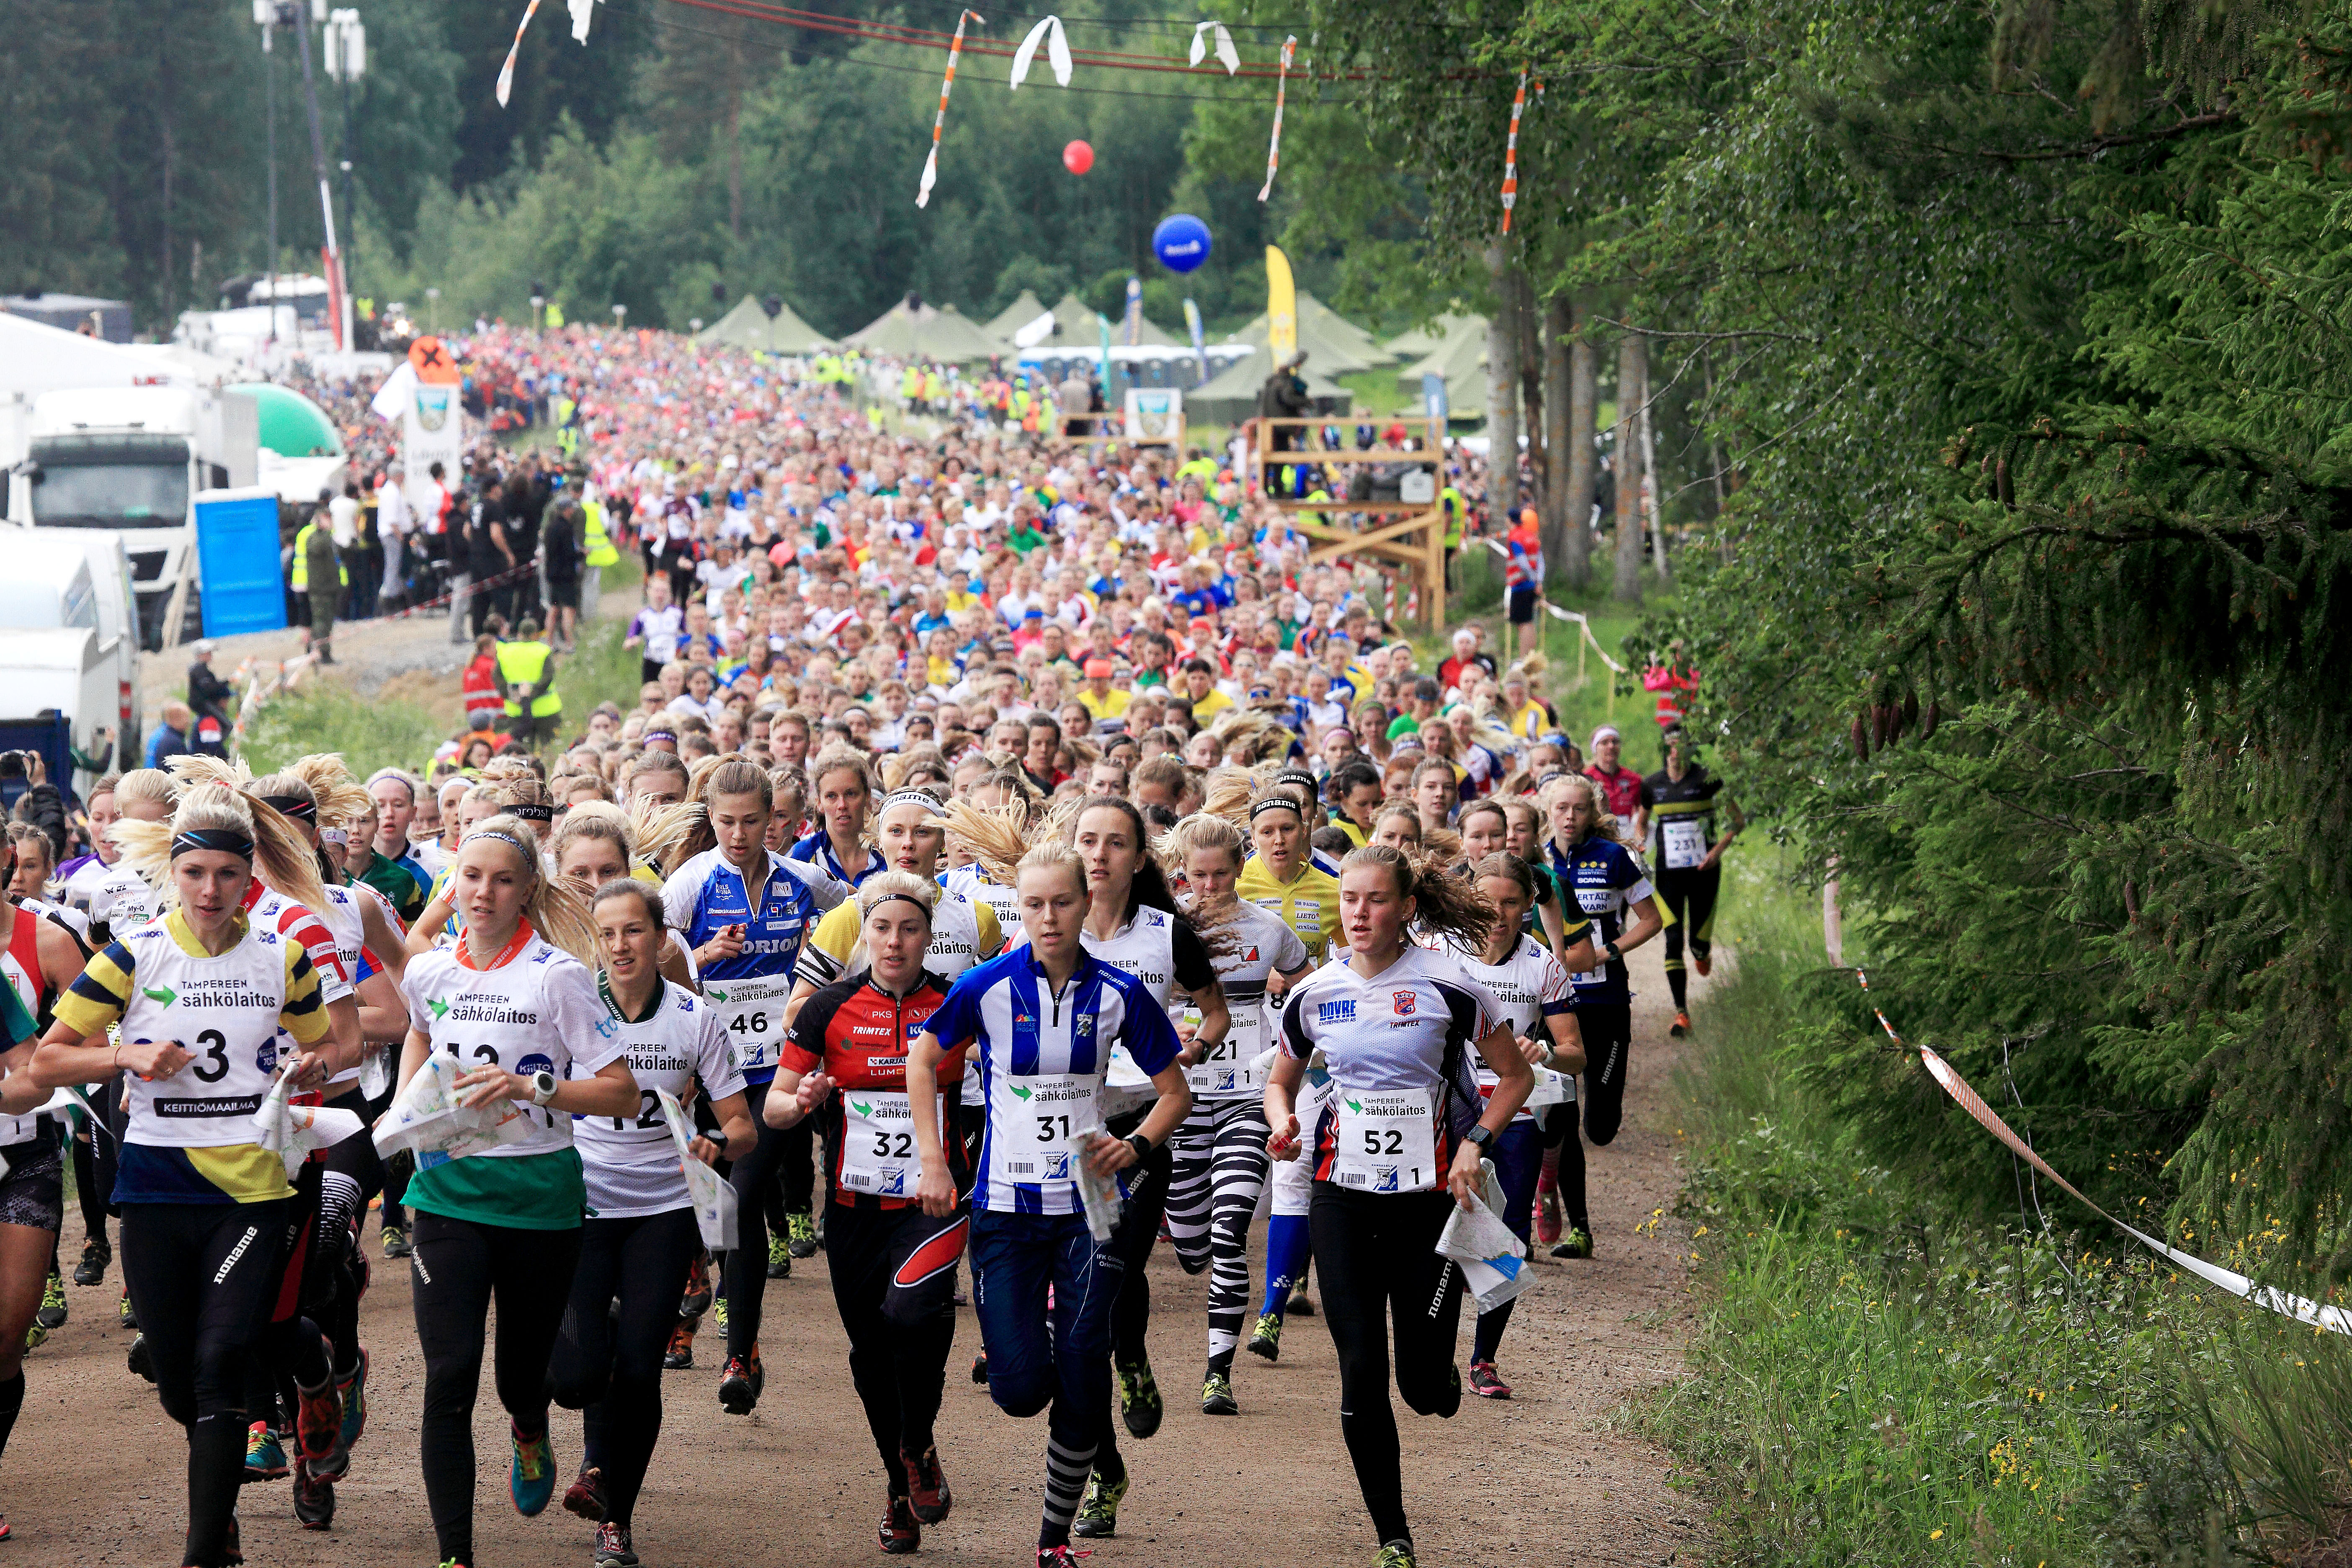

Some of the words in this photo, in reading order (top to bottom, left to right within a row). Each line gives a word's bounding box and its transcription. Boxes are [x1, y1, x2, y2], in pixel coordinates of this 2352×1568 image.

[1277, 775, 1311, 785] oname
[1256, 800, 1295, 812] noname
[931, 941, 972, 955] ölaitos
[182, 980, 247, 989] TAMPEREEN
[1097, 969, 1130, 989] noname
[730, 983, 767, 992] TAMPEREEN
[183, 991, 275, 1007] sähkölaitos
[731, 989, 784, 1003] sähkölaitos
[1493, 990, 1536, 1003] kölaitos
[452, 1006, 536, 1024] sähkölaitos
[603, 995, 624, 1023] nonam
[872, 1011, 892, 1019] PKS
[907, 1007, 936, 1019] JOEN
[730, 1011, 768, 1034] 46
[1231, 1019, 1257, 1028] ölaitos
[1390, 1019, 1420, 1029] TRIMTEX
[853, 1026, 892, 1036] TRIMTEX
[193, 1029, 229, 1083] 3
[774, 1042, 781, 1057] 1
[1211, 1039, 1236, 1061] 21
[626, 1055, 688, 1071] hkölaitos
[1244, 1070, 1250, 1084] 1
[1035, 1088, 1091, 1102] sähkölaitos
[164, 1101, 256, 1112] KEITTIÖMAAILMA
[876, 1108, 911, 1119] sähköl
[1365, 1105, 1426, 1116] sähkölaitos
[1037, 1115, 1069, 1142] 31
[90, 1120, 100, 1159] TRIMTEX
[872, 1132, 912, 1158] 32
[1364, 1130, 1403, 1155] 52
[1411, 1168, 1419, 1185] 1
[213, 1226, 258, 1284] noname
[1428, 1261, 1452, 1318] nonam
